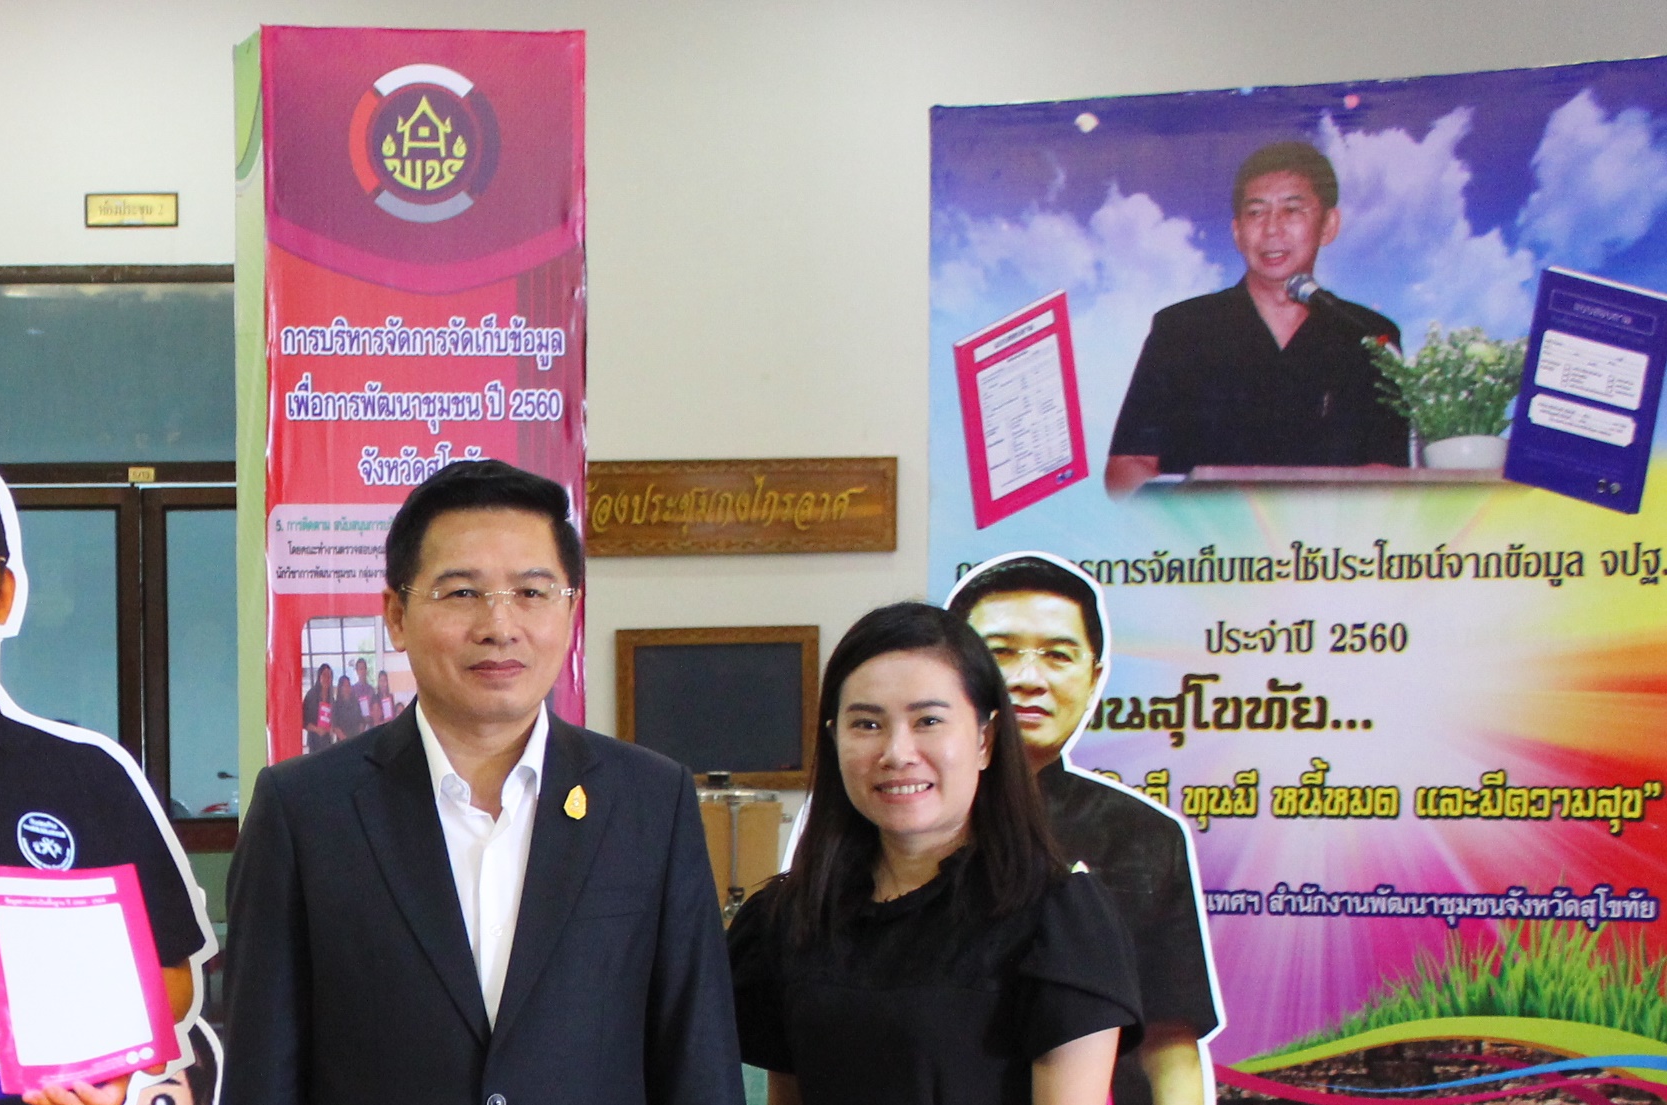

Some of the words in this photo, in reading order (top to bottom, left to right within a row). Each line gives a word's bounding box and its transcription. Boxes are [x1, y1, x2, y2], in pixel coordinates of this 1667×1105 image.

[281, 313, 565, 370] การบริหารจัดการจัดเก็บข้อมูล
[286, 372, 481, 434] เพื่อการพัฒนาชุมชน
[486, 380, 505, 420] ปี
[509, 389, 564, 420] 2560
[1599, 542, 1667, 586] จปฐ.
[1204, 619, 1315, 654] ประจำปี
[1330, 622, 1408, 653] 2560
[1181, 768, 1260, 833] ทุนมี
[1270, 756, 1400, 819] หนี้หมด
[1267, 882, 1660, 931] สำนักงานพัฒนาชุมชนจังหวัดสุโขทัย
